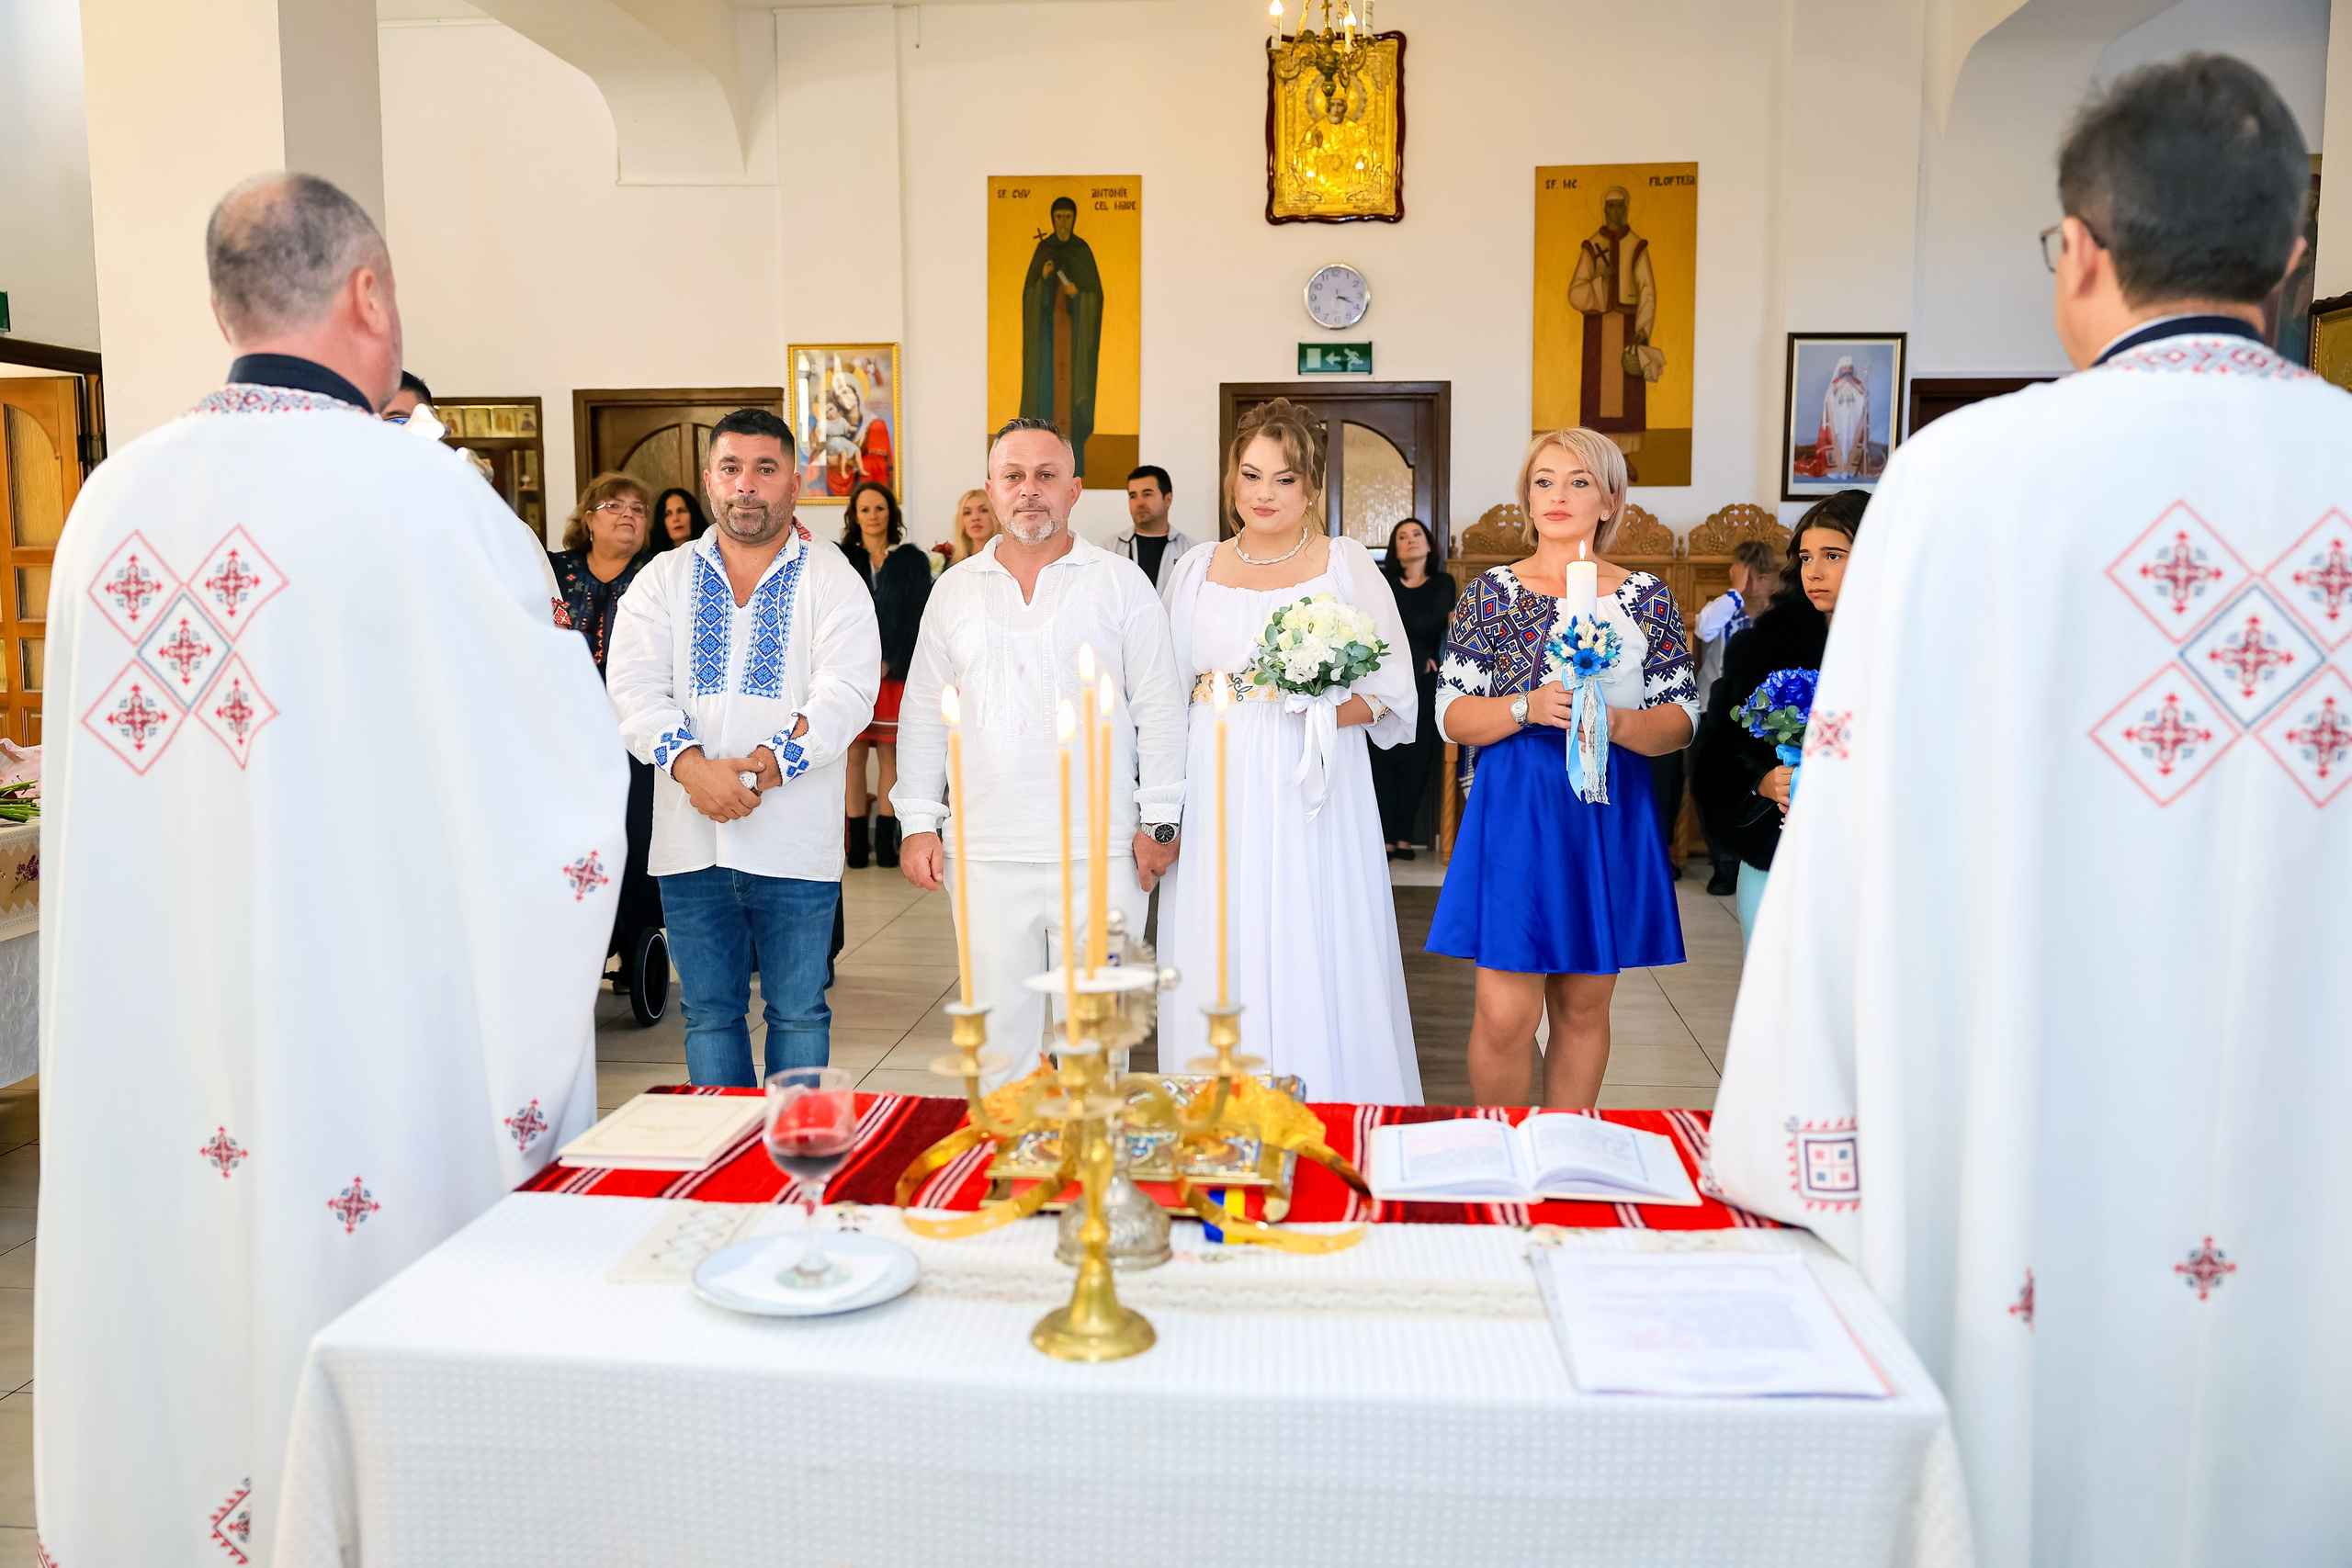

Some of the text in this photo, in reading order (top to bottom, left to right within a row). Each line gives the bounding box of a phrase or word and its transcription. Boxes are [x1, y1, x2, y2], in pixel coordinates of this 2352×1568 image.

[1094, 201, 1108, 210] CEL
[1331, 269, 1340, 277] 12
[1314, 283, 1323, 291] 10
[1352, 280, 1360, 288] 2
[1310, 294, 1317, 302] 9
